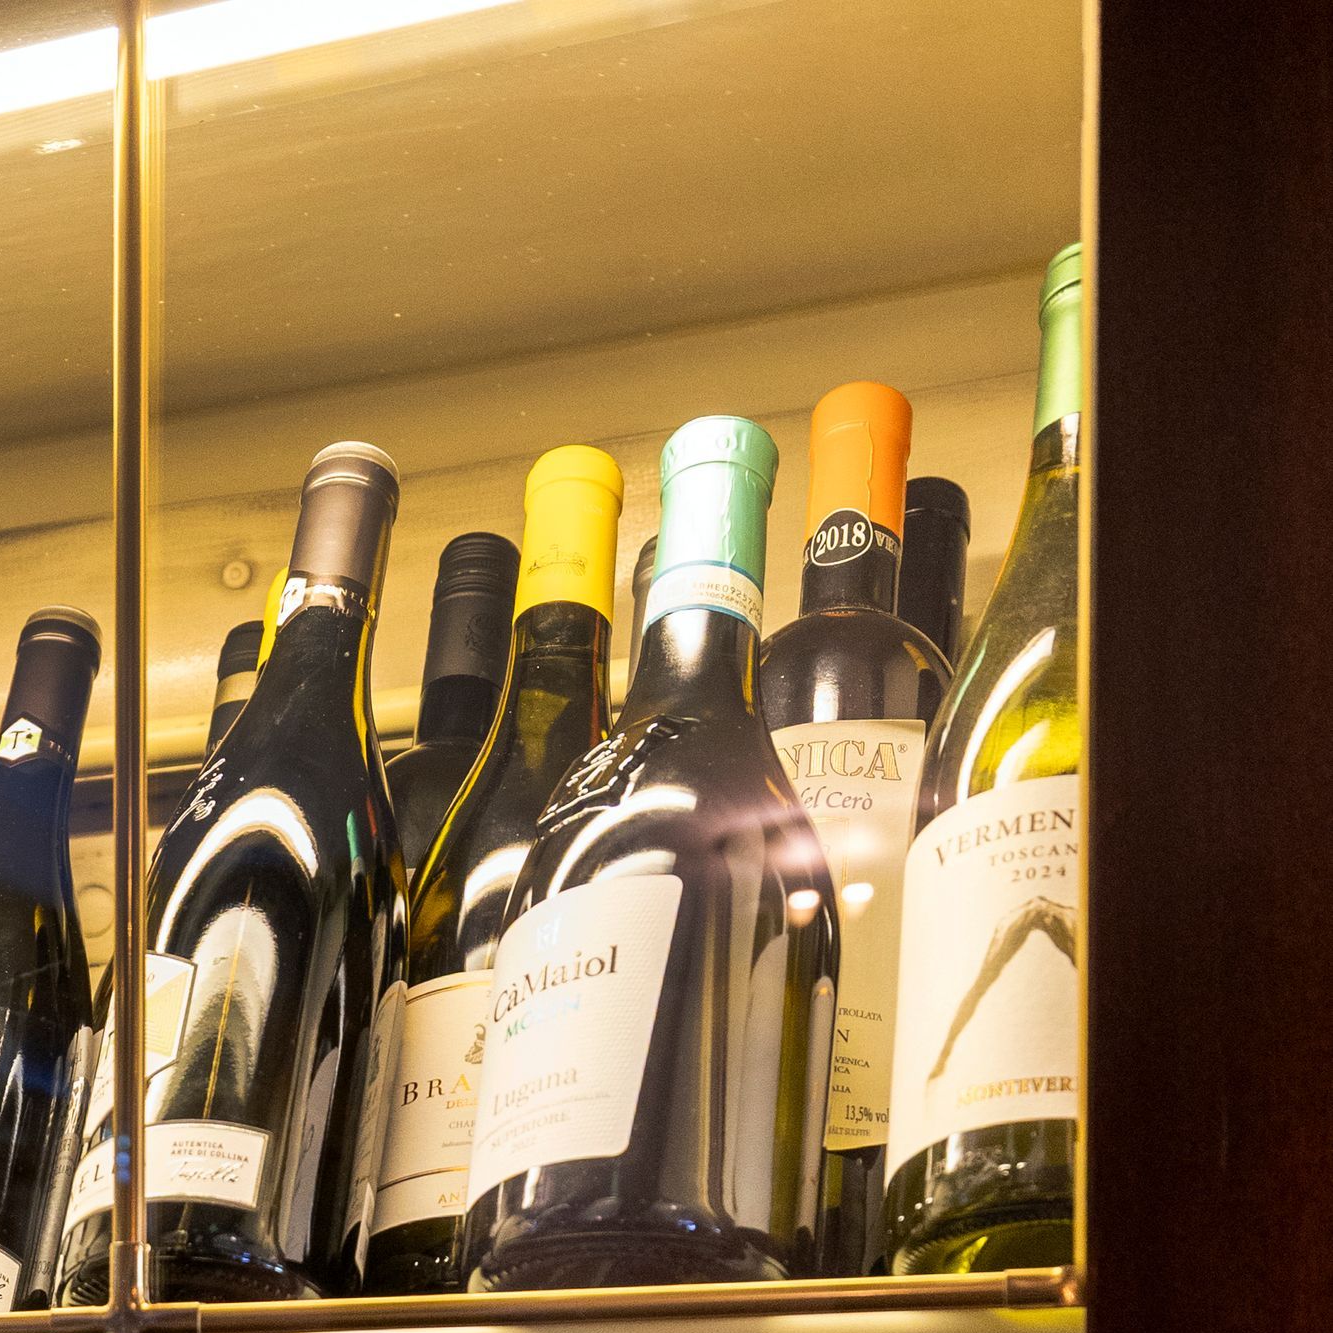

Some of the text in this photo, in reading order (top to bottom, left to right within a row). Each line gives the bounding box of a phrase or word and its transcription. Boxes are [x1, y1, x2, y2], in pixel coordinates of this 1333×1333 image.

[815, 521, 866, 558] 2018
[824, 790, 874, 812] Cerò
[934, 807, 1075, 868] VERMEN
[1011, 868, 1068, 884] 2024
[494, 944, 618, 1022] CàMaiol
[838, 1007, 883, 1022] TROLLATA
[493, 1067, 578, 1116] Lugana
[845, 1104, 889, 1124] 13,5% vol
[172, 1140, 224, 1150] AUTENTICA
[171, 1149, 250, 1164] ARTE DI COLLINA
